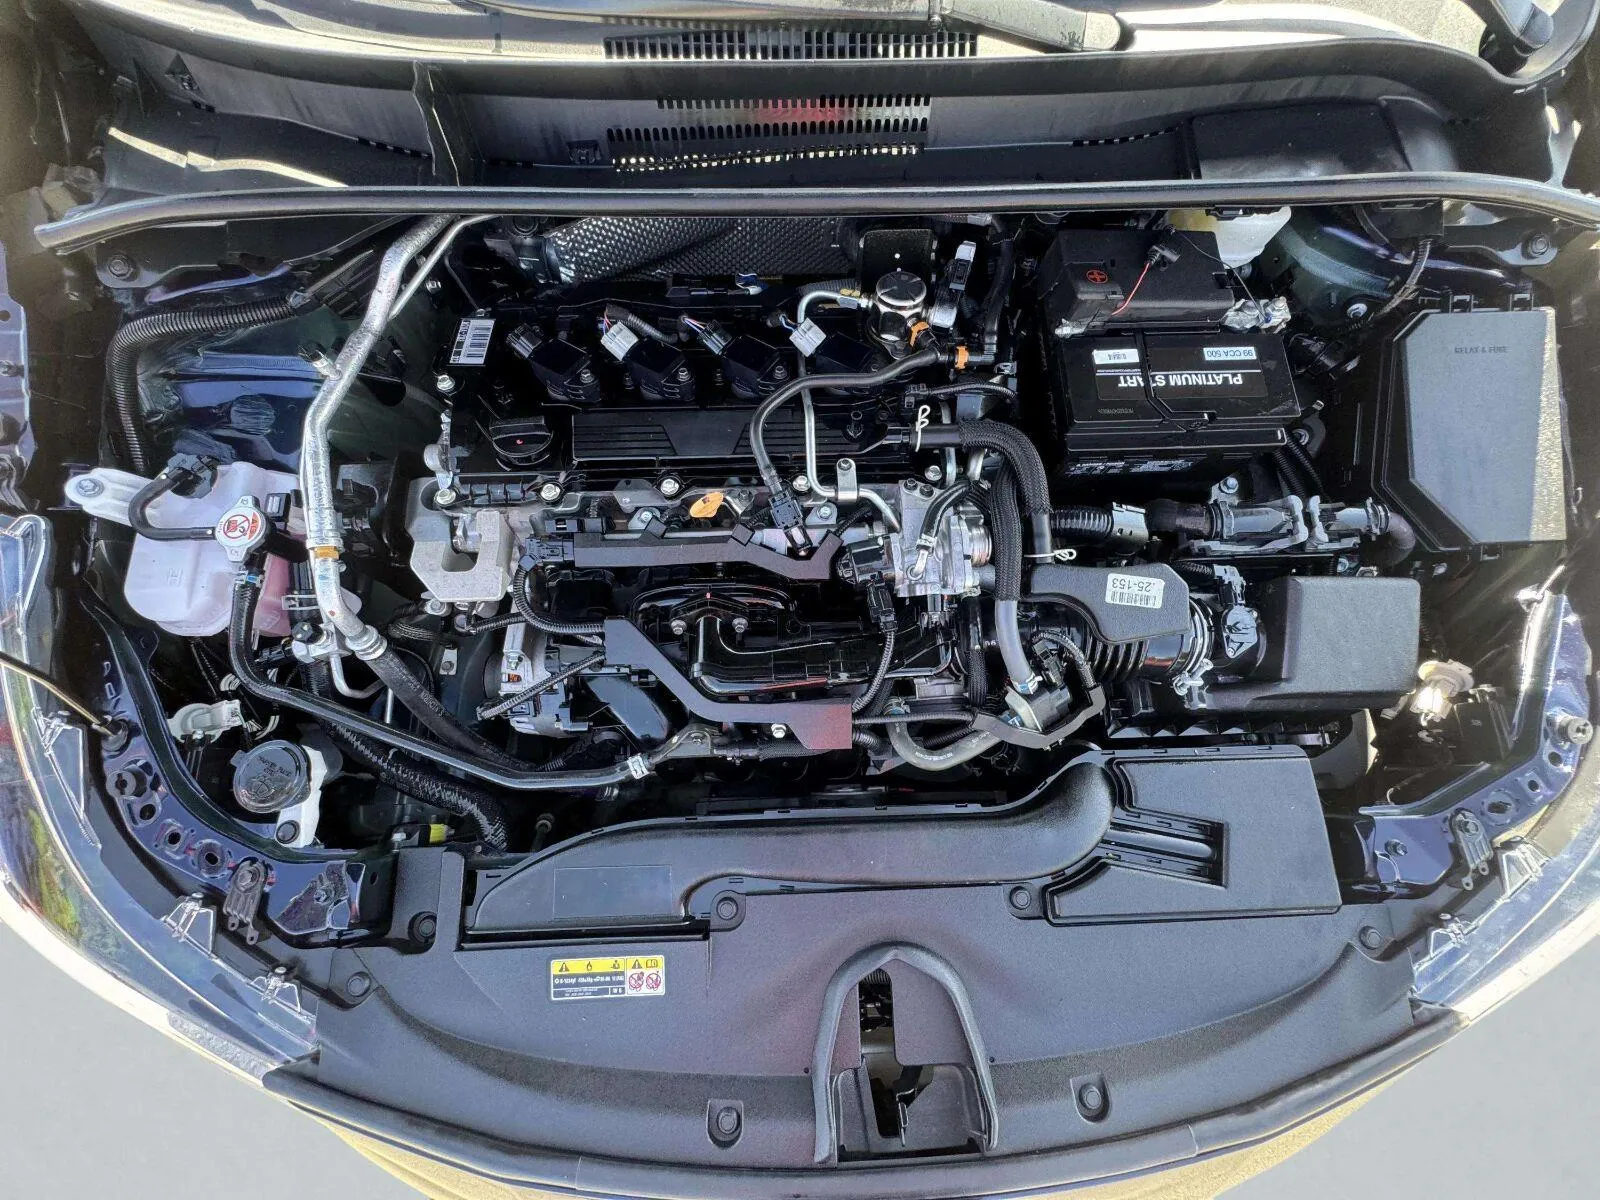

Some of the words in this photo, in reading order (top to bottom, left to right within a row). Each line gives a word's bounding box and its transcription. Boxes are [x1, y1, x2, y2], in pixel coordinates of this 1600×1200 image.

[1206, 350, 1222, 358] 500
[1223, 349, 1242, 357] CCA
[1169, 373, 1243, 386] PLATINUM
